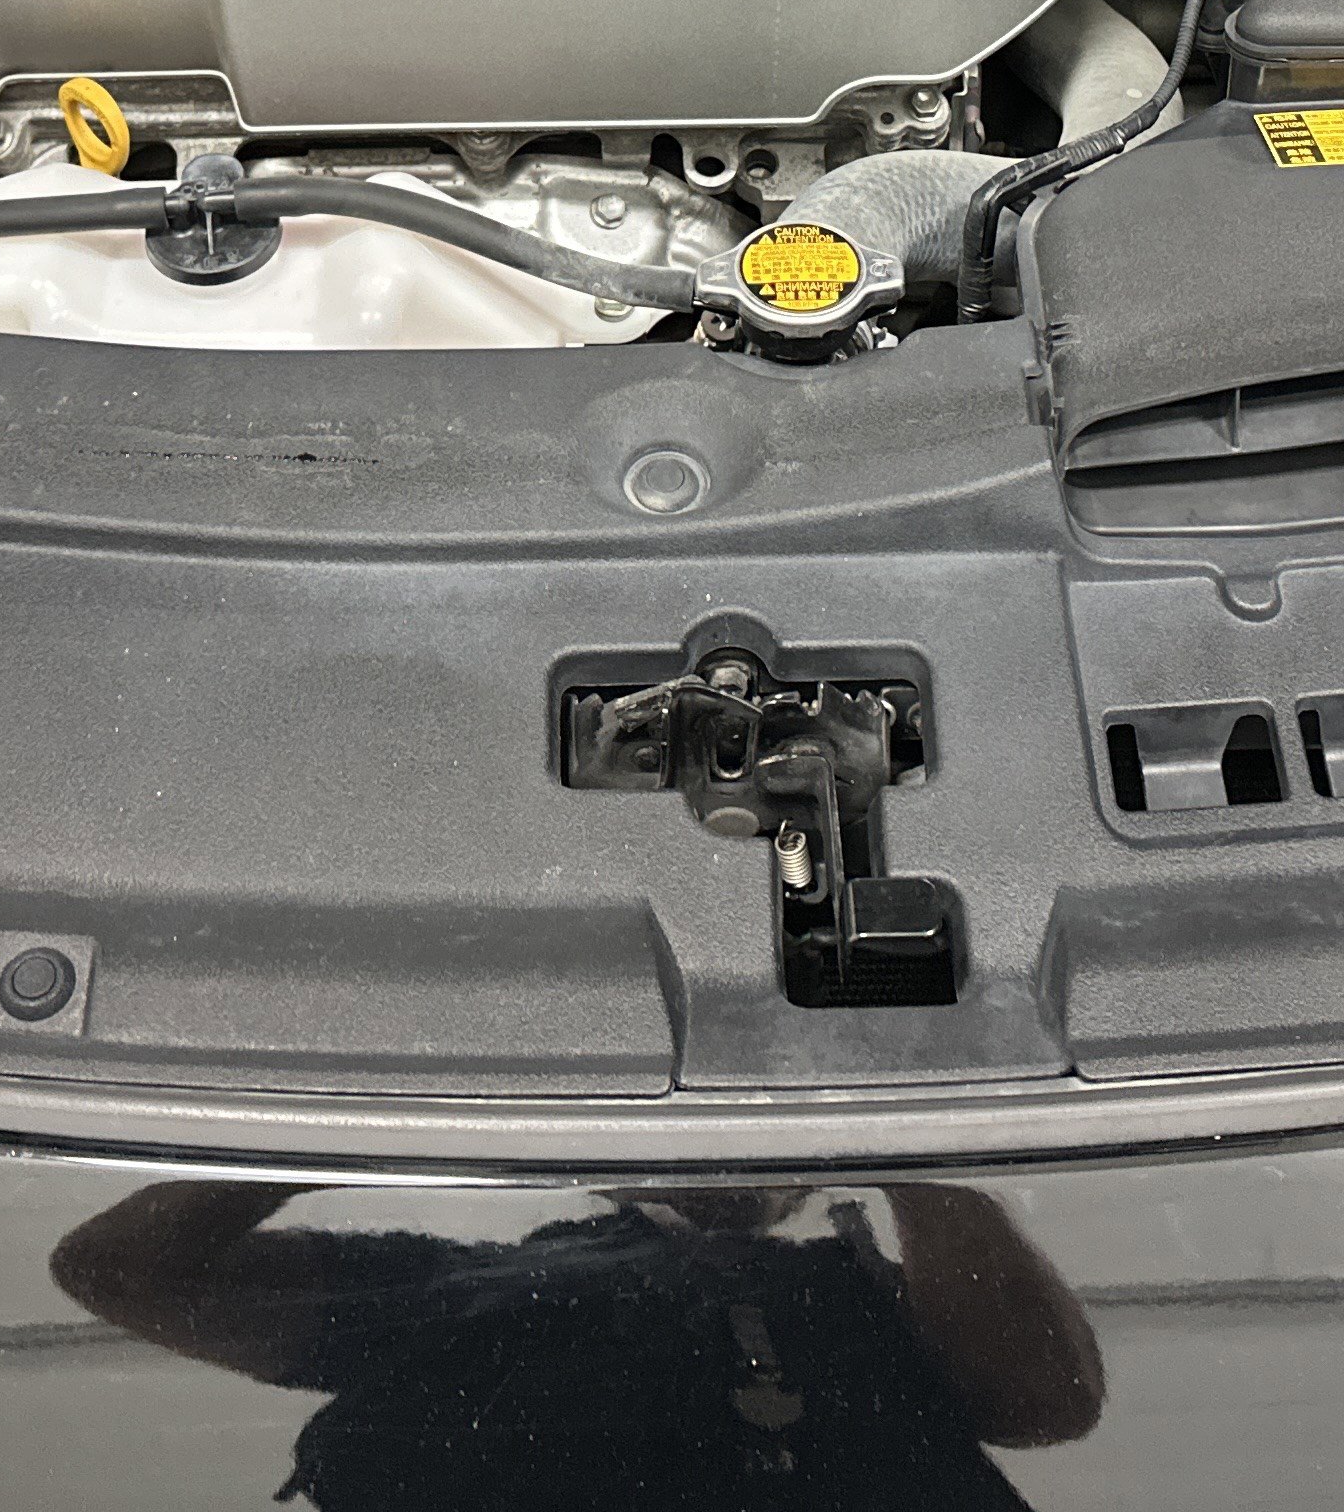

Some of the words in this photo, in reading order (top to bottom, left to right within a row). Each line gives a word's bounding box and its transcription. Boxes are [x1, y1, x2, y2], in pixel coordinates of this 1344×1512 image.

[774, 226, 820, 236] CAUTION
[775, 234, 834, 243] ATTENTION
[775, 282, 844, 292] ВНИМАНИЕ!
